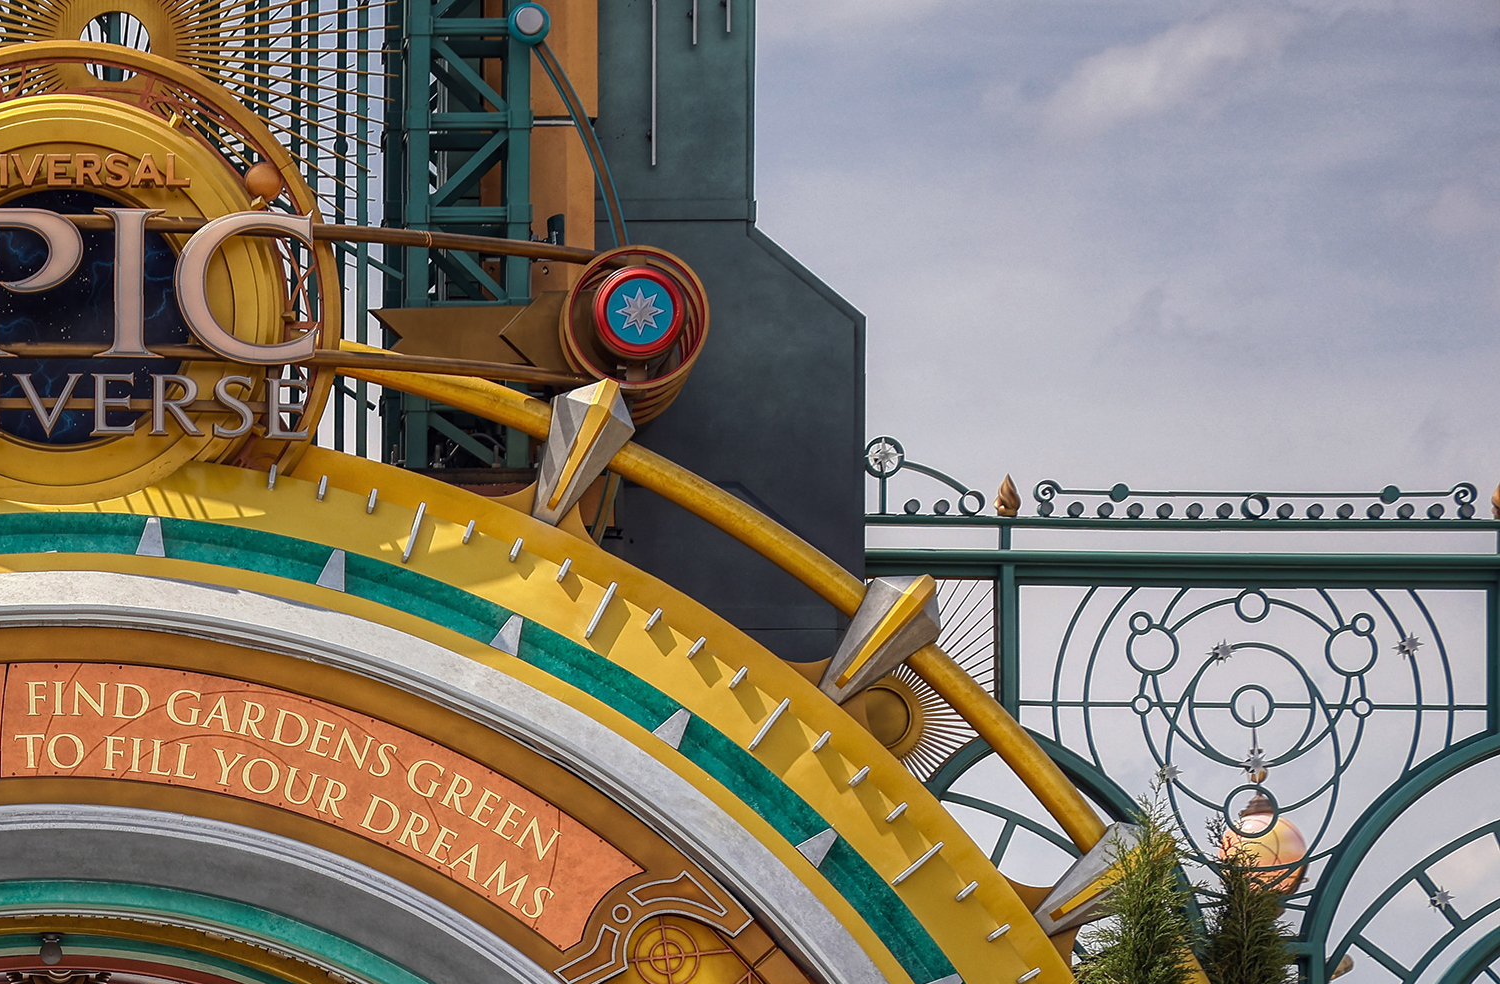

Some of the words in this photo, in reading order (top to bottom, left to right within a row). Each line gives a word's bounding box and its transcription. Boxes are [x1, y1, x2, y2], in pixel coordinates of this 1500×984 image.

[14, 733, 86, 770] TO
[102, 735, 197, 780] FILL
[213, 748, 347, 820] YOUR
[358, 793, 556, 919] DREAMS
[25, 680, 150, 719] FIND
[166, 689, 398, 777] GARDENS
[407, 759, 562, 862] GREEN
